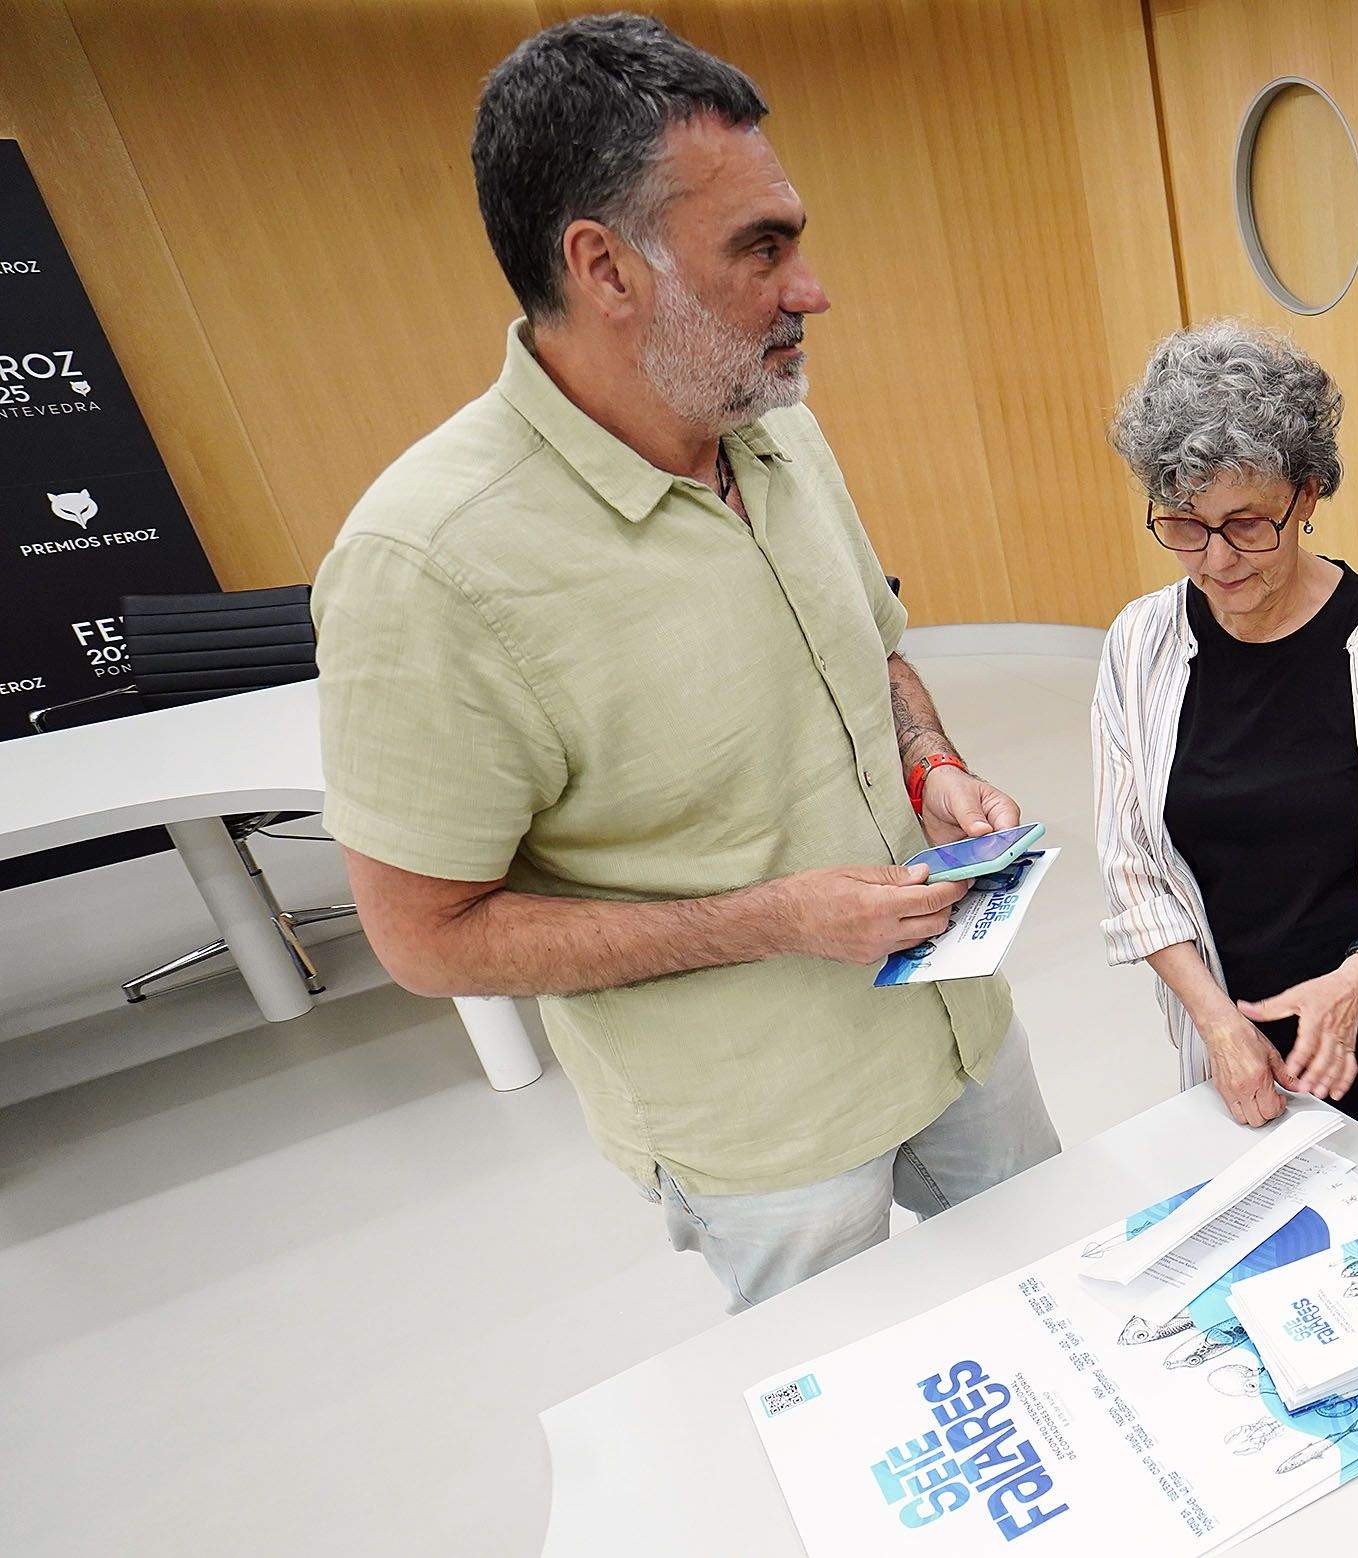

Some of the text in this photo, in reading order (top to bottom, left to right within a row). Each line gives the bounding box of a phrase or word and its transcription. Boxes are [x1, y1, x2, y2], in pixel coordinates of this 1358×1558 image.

[20, 528, 160, 557] PREMIOS FEROZ
[71, 616, 125, 646] FE
[870, 1430, 971, 1529] SETE
